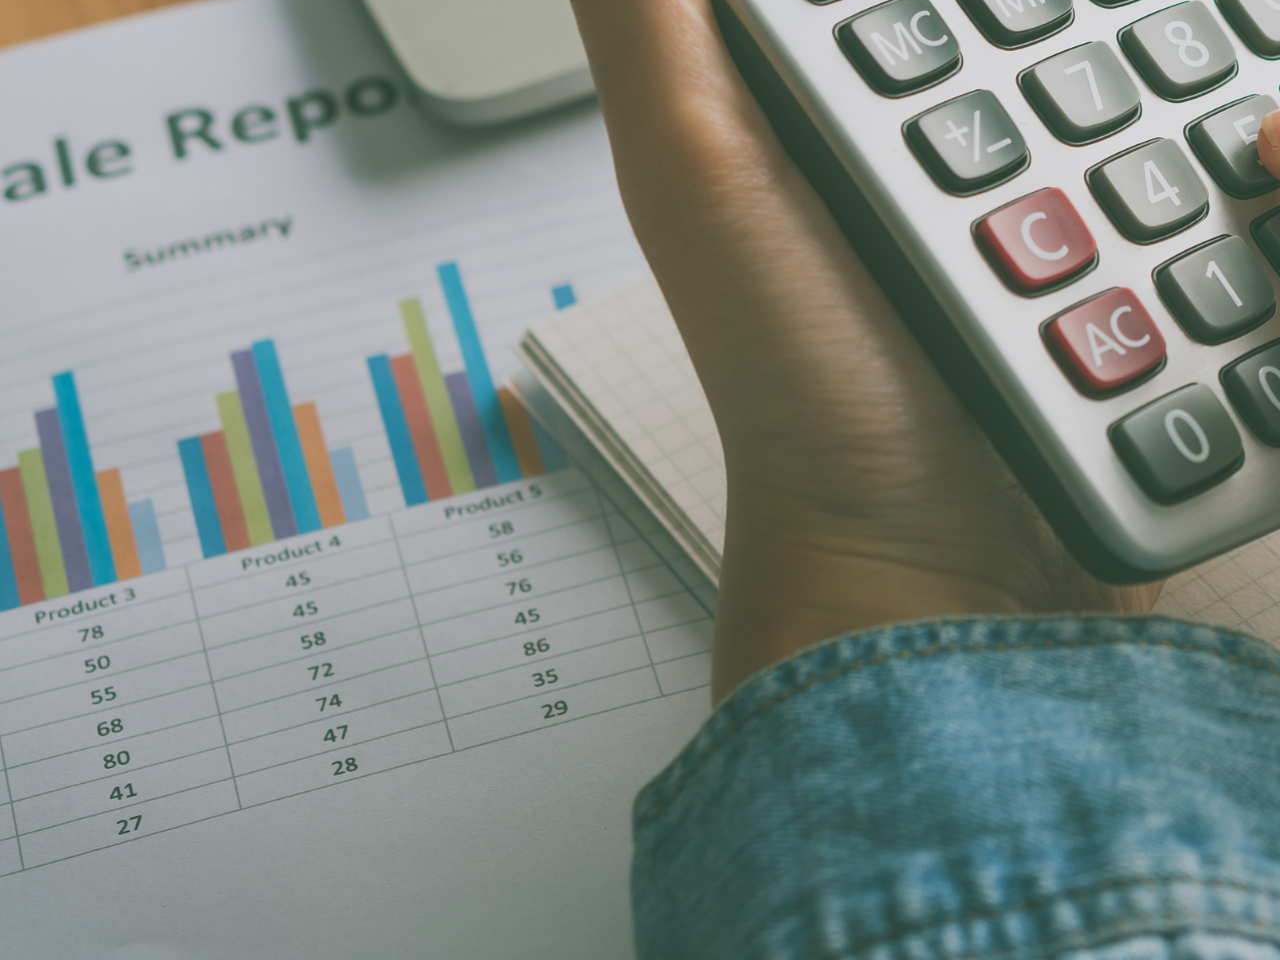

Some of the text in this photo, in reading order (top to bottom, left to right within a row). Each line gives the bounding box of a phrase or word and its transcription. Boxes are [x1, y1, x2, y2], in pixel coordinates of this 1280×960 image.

[870, 9, 948, 65] MC
[1164, 20, 1209, 68] 8
[1063, 58, 1104, 111] 7
[1144, 161, 1181, 208] 4
[122, 215, 294, 272] Summary
[1021, 212, 1068, 261] C
[1205, 261, 1243, 308] 1
[1083, 306, 1150, 366] AC
[1164, 409, 1209, 463] 0
[443, 485, 542, 520] Product 5
[488, 520, 514, 538] 58
[241, 537, 341, 571] Product 4
[497, 549, 523, 567] 56
[285, 571, 312, 589] 45
[505, 578, 531, 596] 76
[34, 588, 136, 625] Product 3
[293, 600, 319, 619] 45
[514, 608, 540, 626] 45
[78, 624, 104, 643] 78
[300, 631, 326, 649] 58
[523, 638, 549, 657] 86
[84, 655, 111, 673] 50
[307, 661, 335, 681] 72
[531, 668, 558, 688] 35
[90, 686, 117, 705] 55
[315, 693, 343, 712] 74
[541, 700, 569, 719] 29
[96, 718, 124, 737] 68
[323, 724, 349, 743] 47
[103, 749, 131, 769] 80
[331, 756, 358, 776] 28
[109, 782, 137, 801] 41
[116, 815, 143, 835] 27
